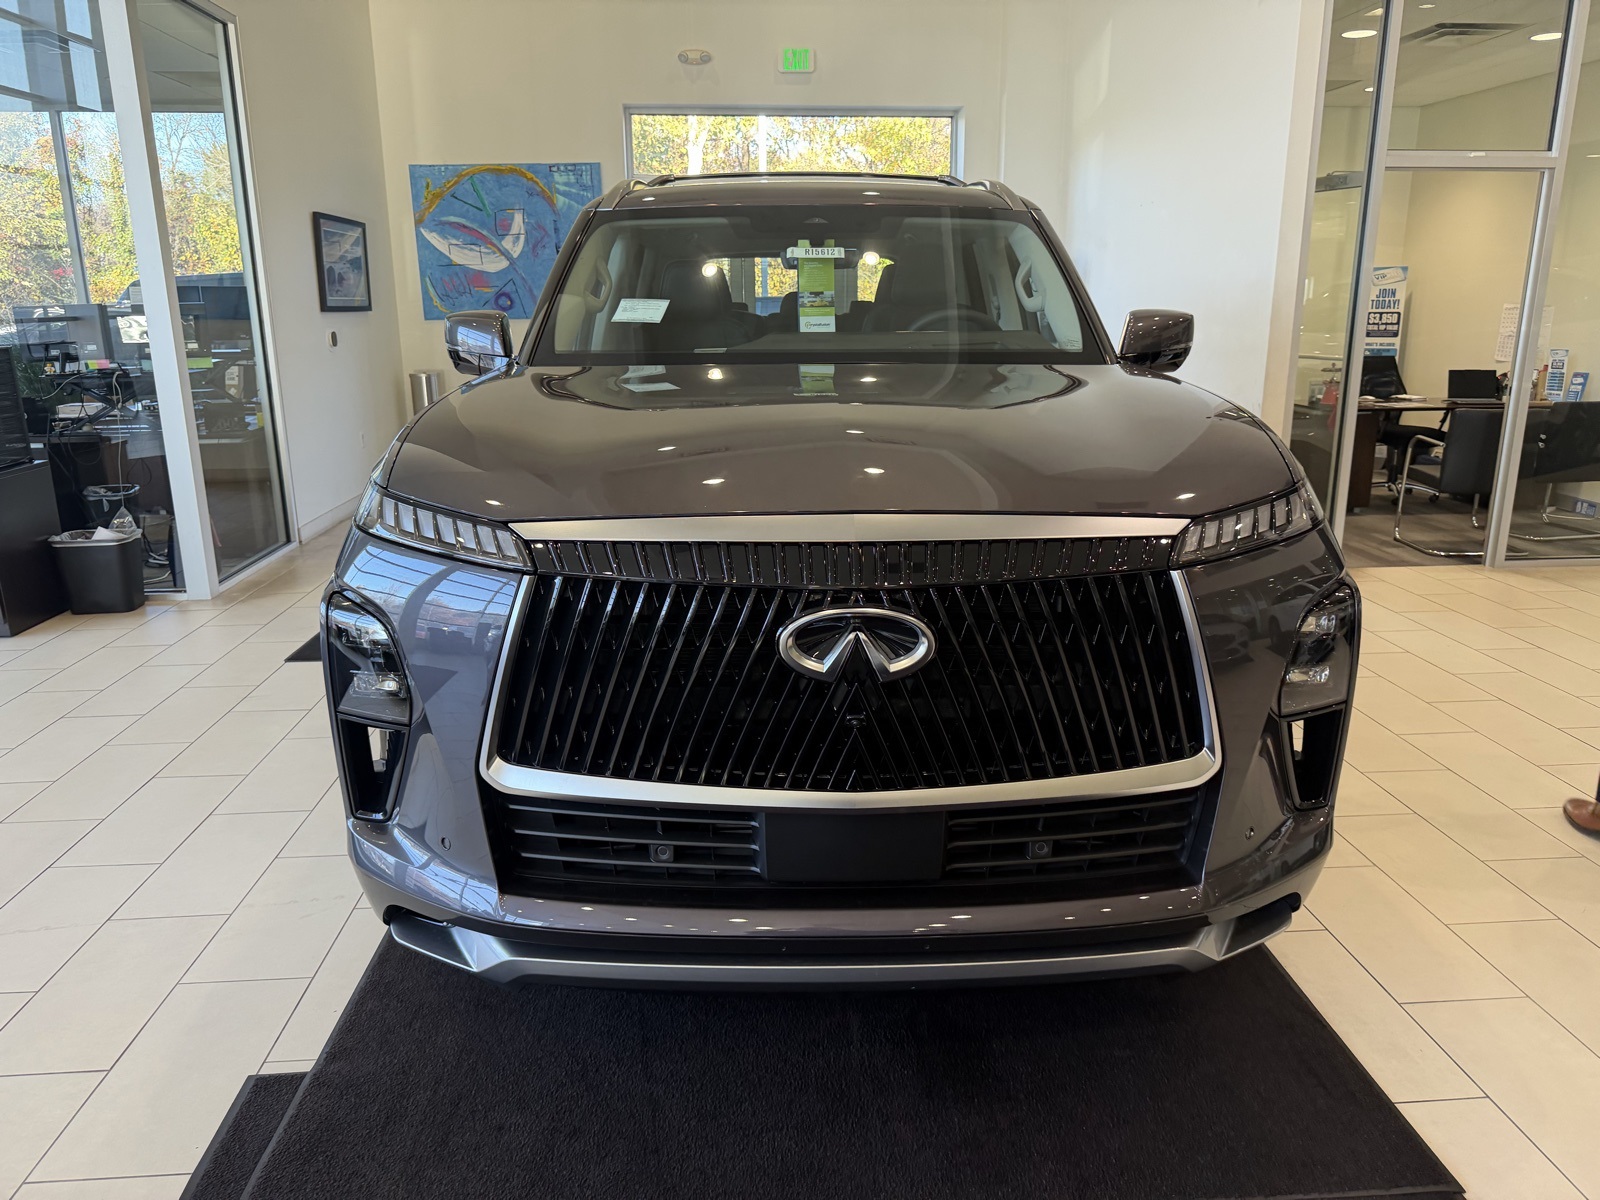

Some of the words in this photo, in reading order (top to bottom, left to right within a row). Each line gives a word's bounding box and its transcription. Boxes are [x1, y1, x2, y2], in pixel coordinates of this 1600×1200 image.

[783, 49, 809, 70] EXIT
[804, 248, 836, 256] R15612
[1376, 288, 1396, 298] JOIN
[1370, 299, 1400, 309] TODAY!
[1369, 313, 1398, 324] $3,850
